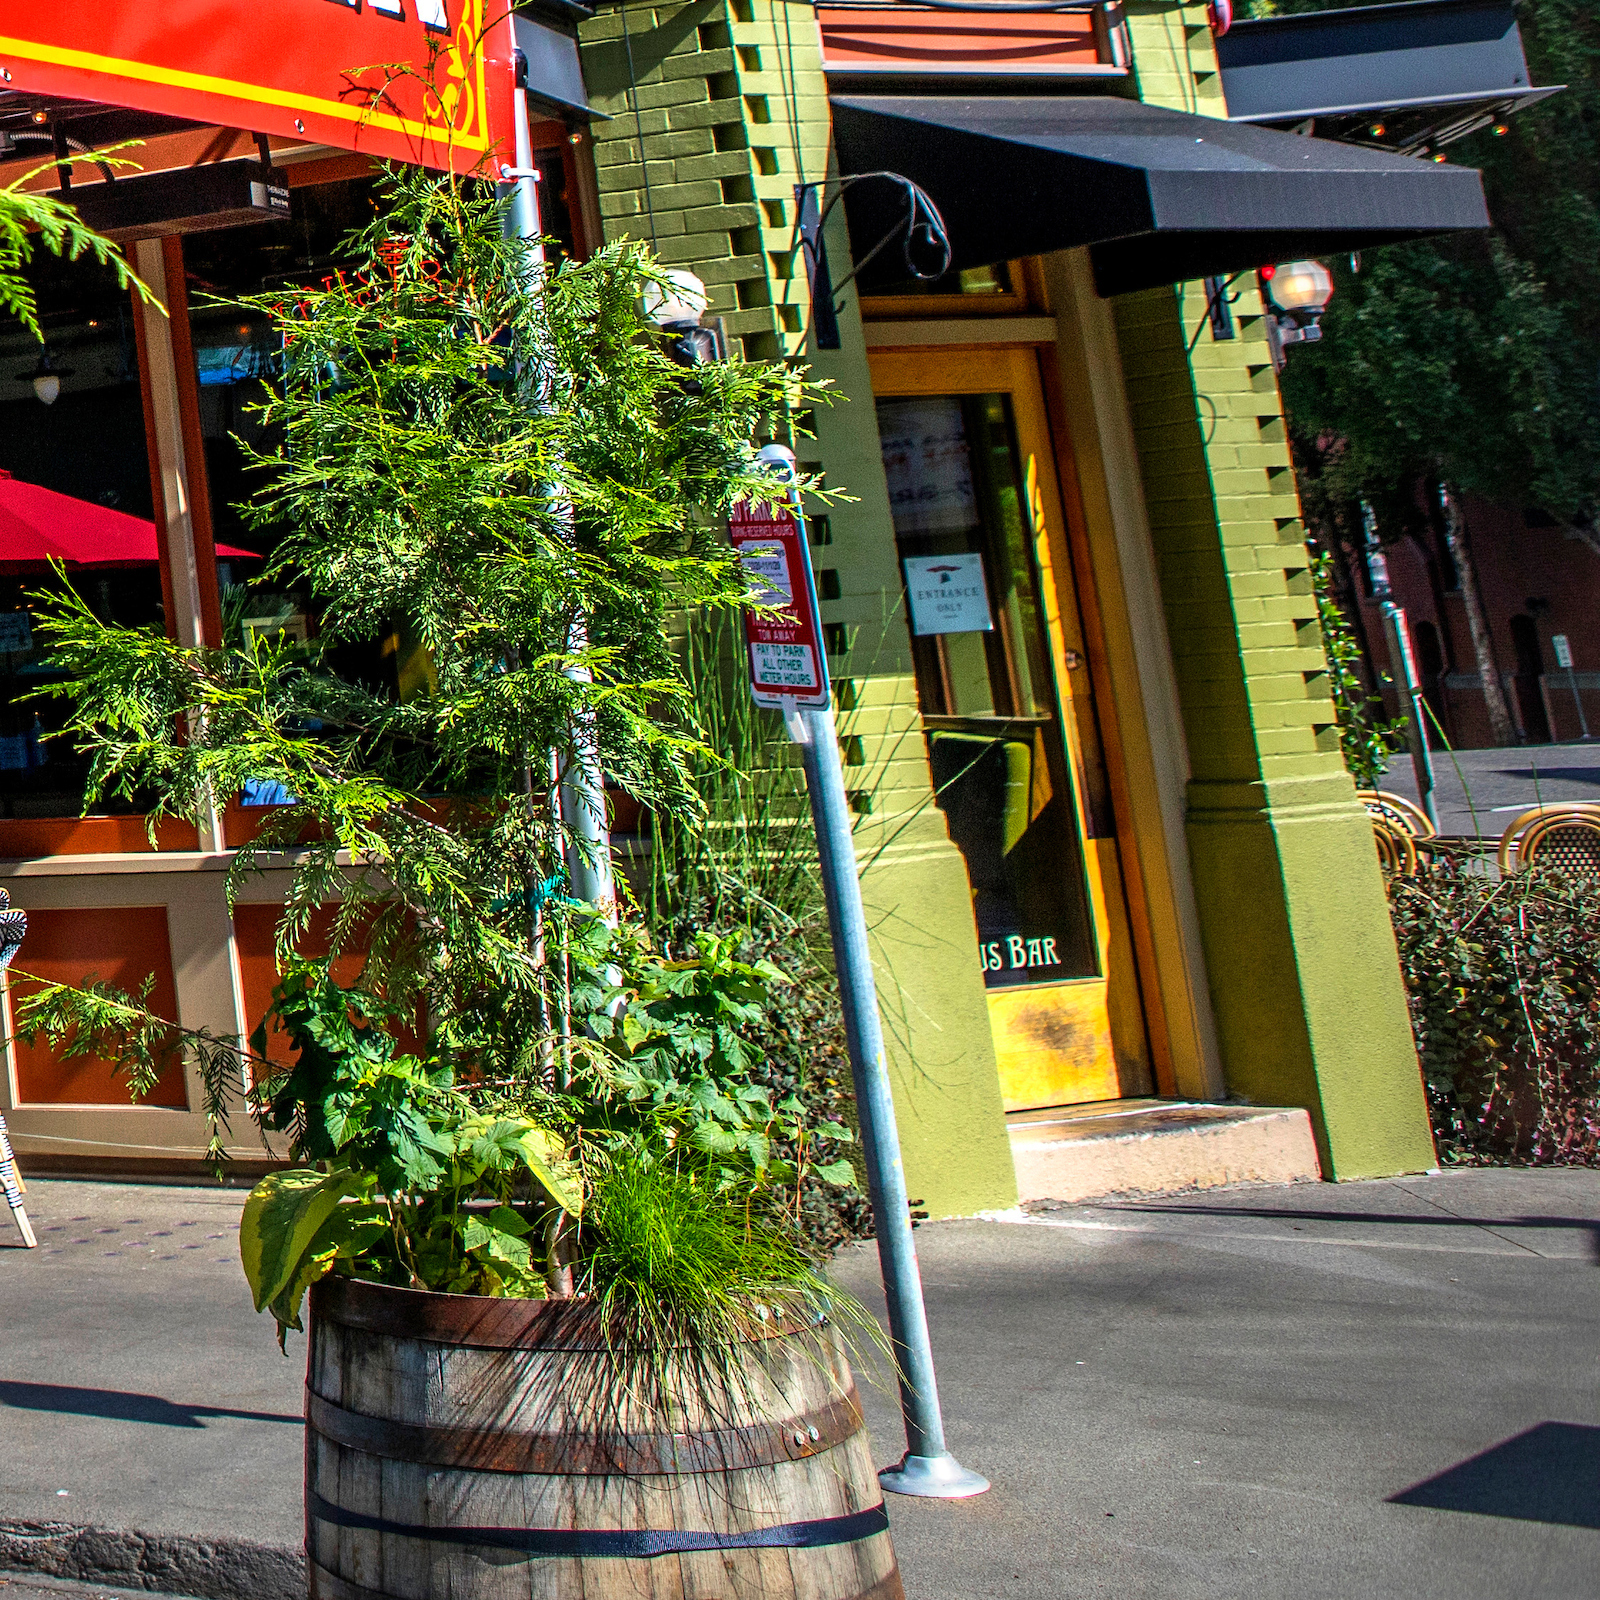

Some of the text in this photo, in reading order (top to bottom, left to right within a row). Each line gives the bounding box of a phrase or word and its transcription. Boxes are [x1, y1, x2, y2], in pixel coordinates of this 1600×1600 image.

[773, 523, 795, 537] HOURS
[917, 586, 981, 601] ENTRANCE
[936, 602, 963, 613] ONLY
[772, 629, 796, 642] AWAY
[756, 643, 806, 658] PAY TO PARK
[763, 658, 803, 671] ALL OTHER
[760, 671, 812, 686] METER HOURS
[1006, 935, 1062, 969] BAR
